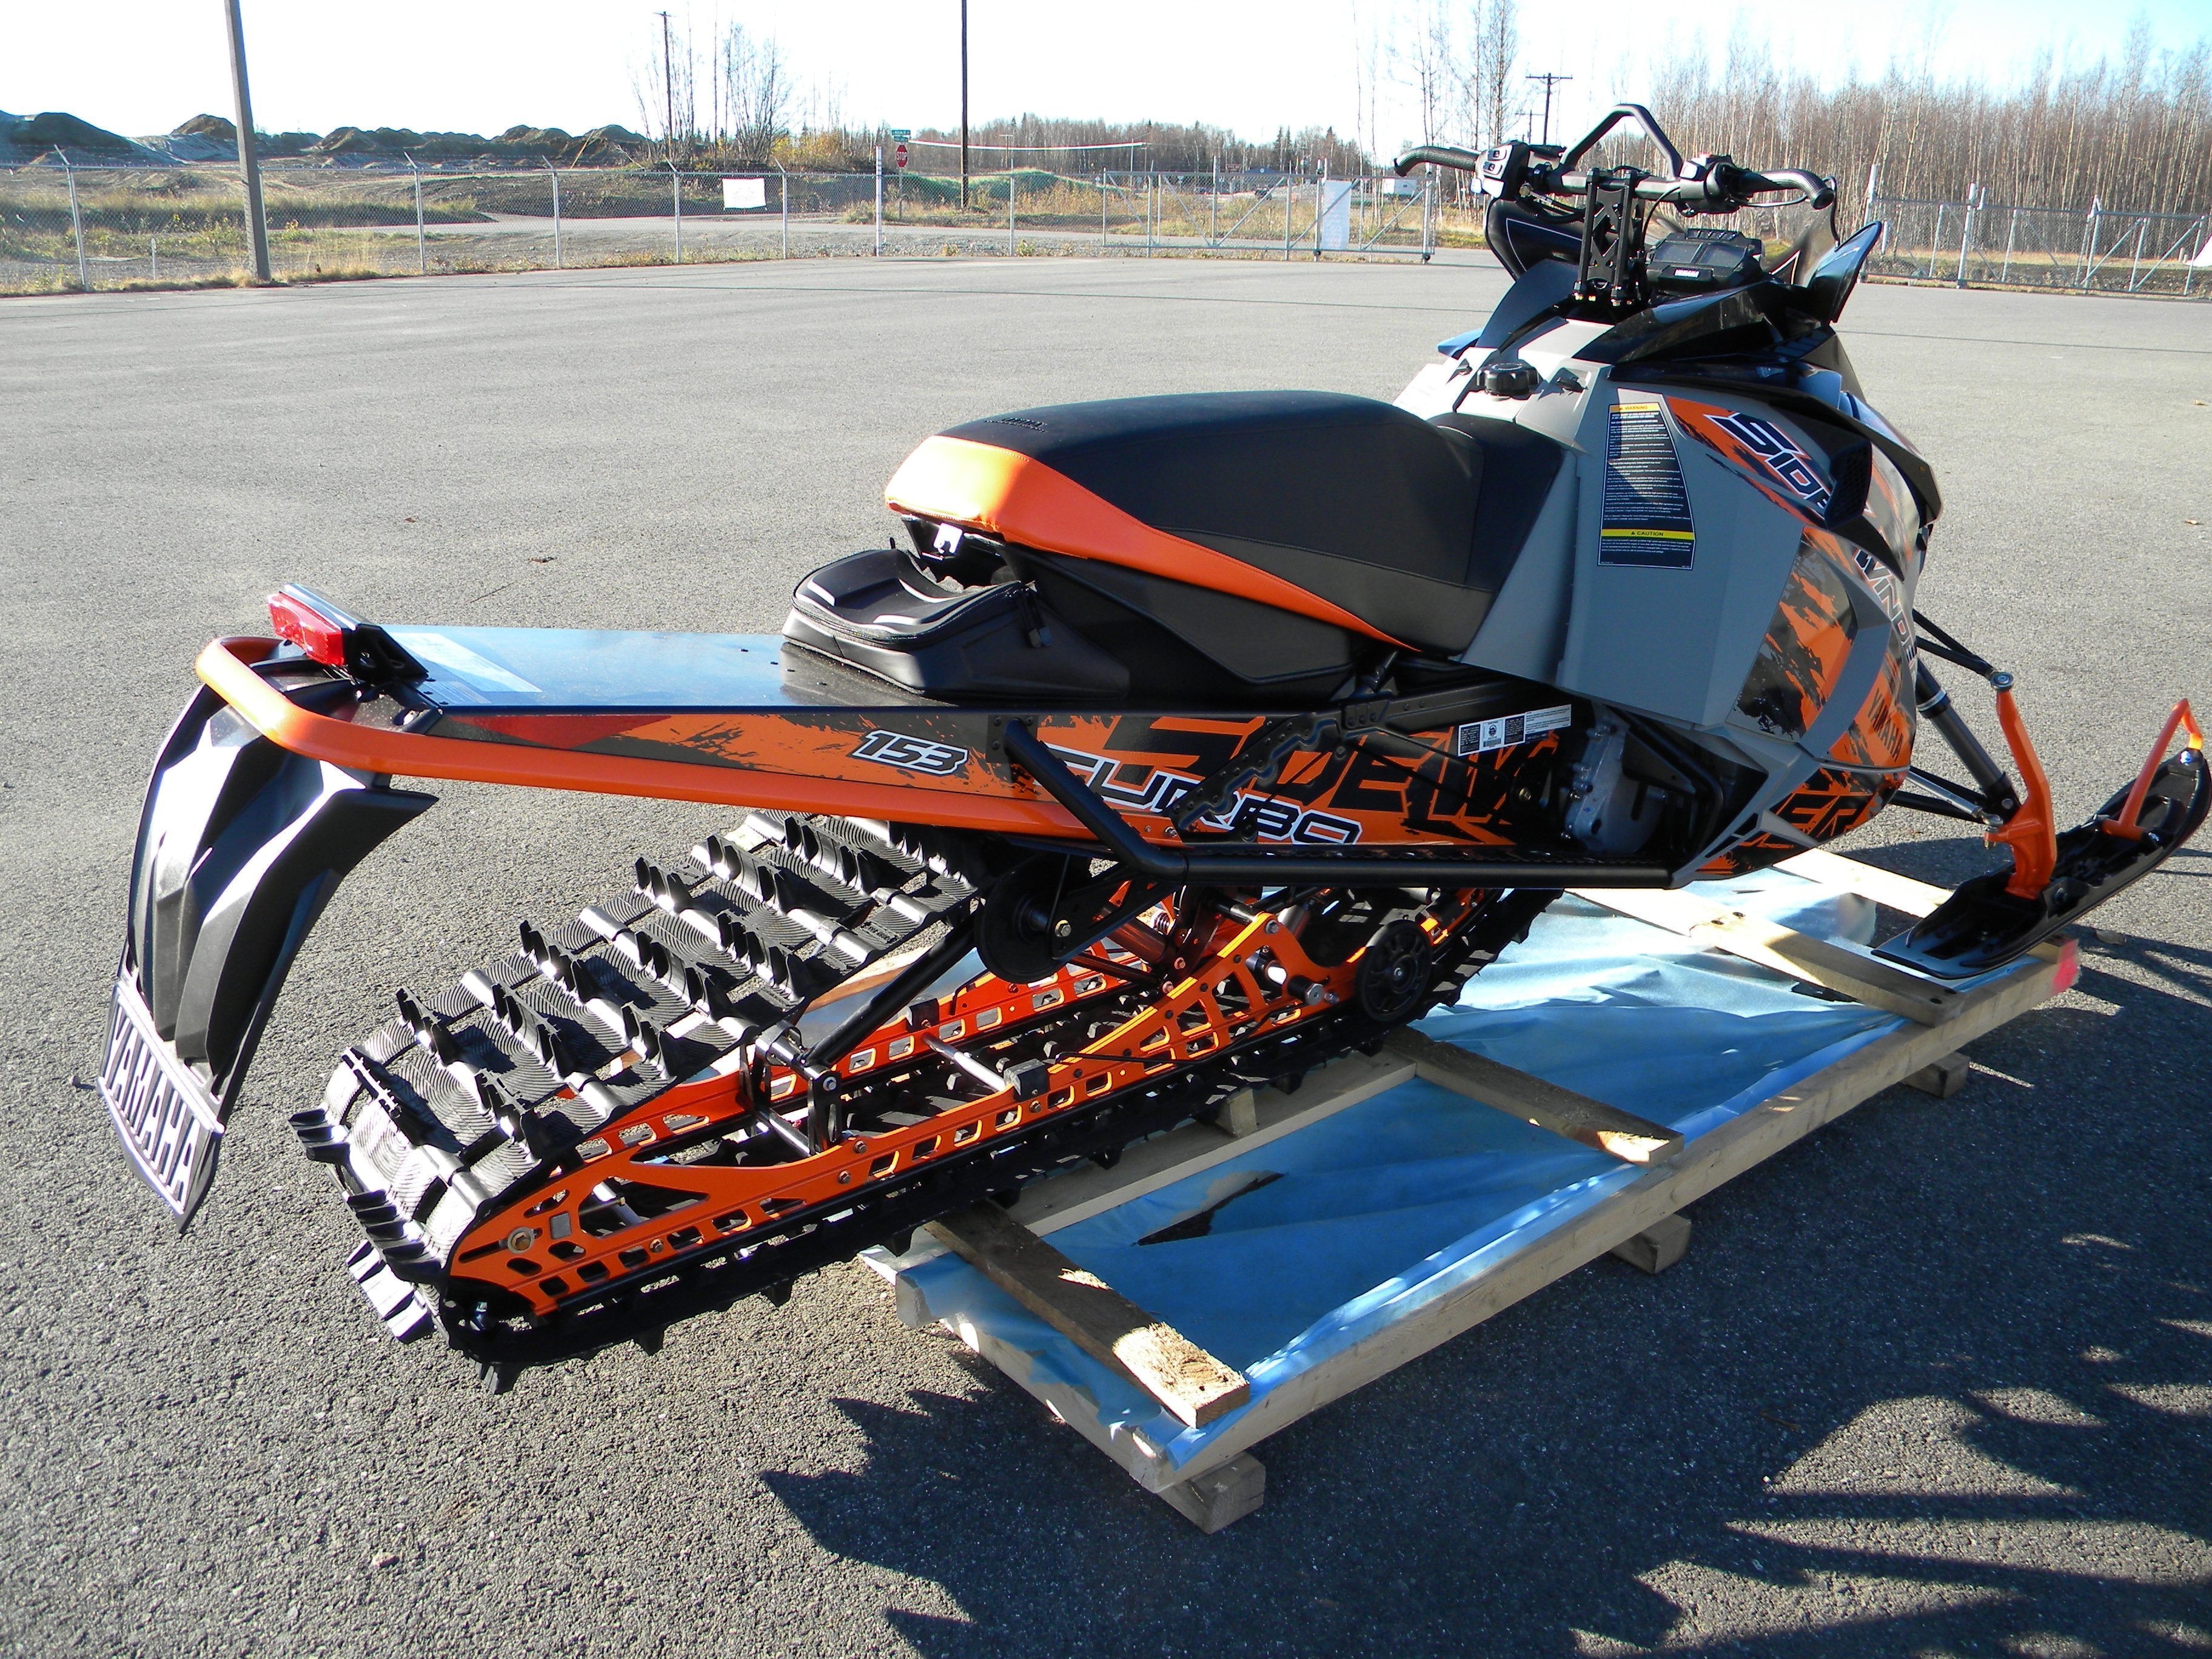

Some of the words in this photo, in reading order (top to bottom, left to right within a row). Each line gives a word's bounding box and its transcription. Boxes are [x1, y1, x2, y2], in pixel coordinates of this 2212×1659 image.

[897, 151, 908, 161] STOP
[851, 729, 968, 776] 153
[1867, 688, 1904, 763] YAMAHA
[103, 1002, 201, 1213] YAMAHA
